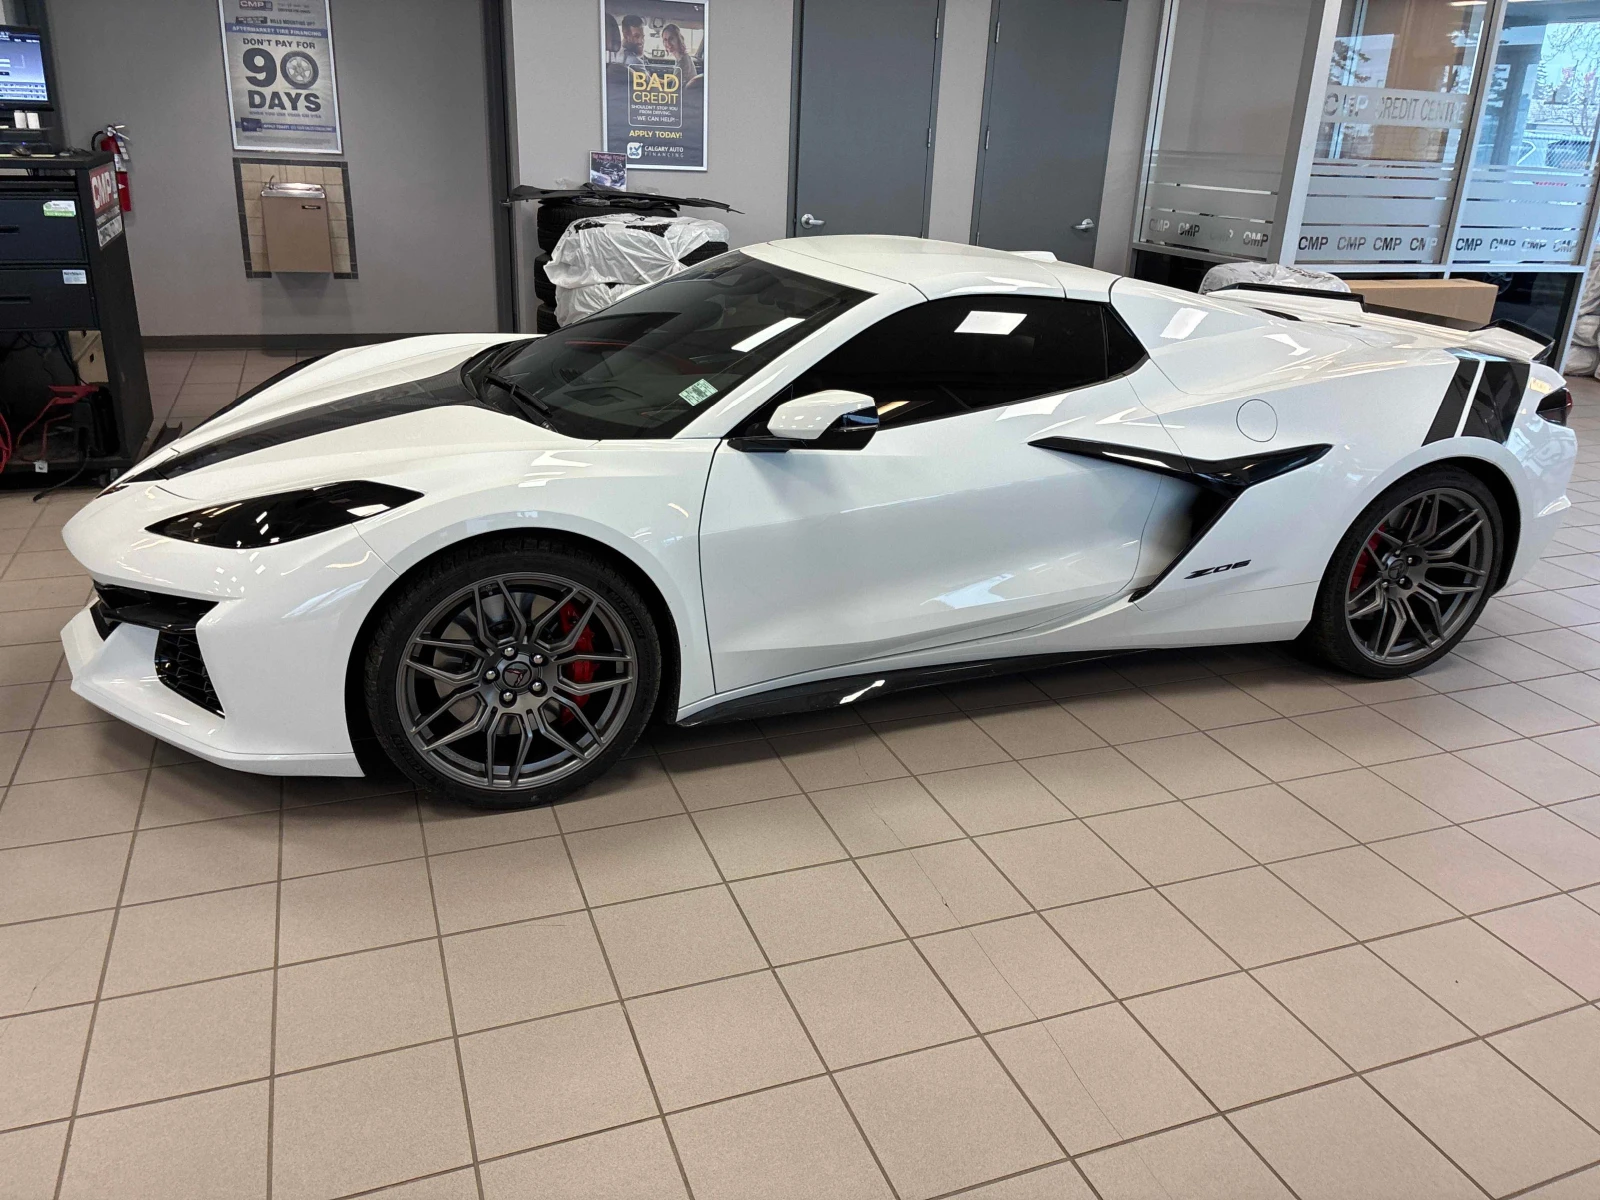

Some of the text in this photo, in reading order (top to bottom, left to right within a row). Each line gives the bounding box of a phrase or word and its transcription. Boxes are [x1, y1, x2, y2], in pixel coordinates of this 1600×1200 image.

[240, 0, 264, 8] CMP
[232, 26, 275, 34] AFTERMARKET
[290, 29, 322, 37] FINANCING
[242, 37, 316, 49] DON'T PAY FOR
[242, 47, 320, 90] 90
[633, 72, 680, 92] BAD
[248, 90, 322, 112] DAYS
[632, 92, 679, 104] CREDIT
[1420, 98, 1468, 124] CENTRE
[629, 130, 683, 139] APPLY TODAY!
[91, 170, 112, 209] CMP
[1178, 222, 1201, 237] CMP
[1242, 230, 1269, 248] CMP
[1298, 236, 1438, 251] CMP CMP CMP CMP
[1455, 238, 1483, 251] CMP
[1489, 238, 1517, 252] CMP
[1183, 558, 1252, 580] Z06
[605, 587, 645, 640] MICHELIN
